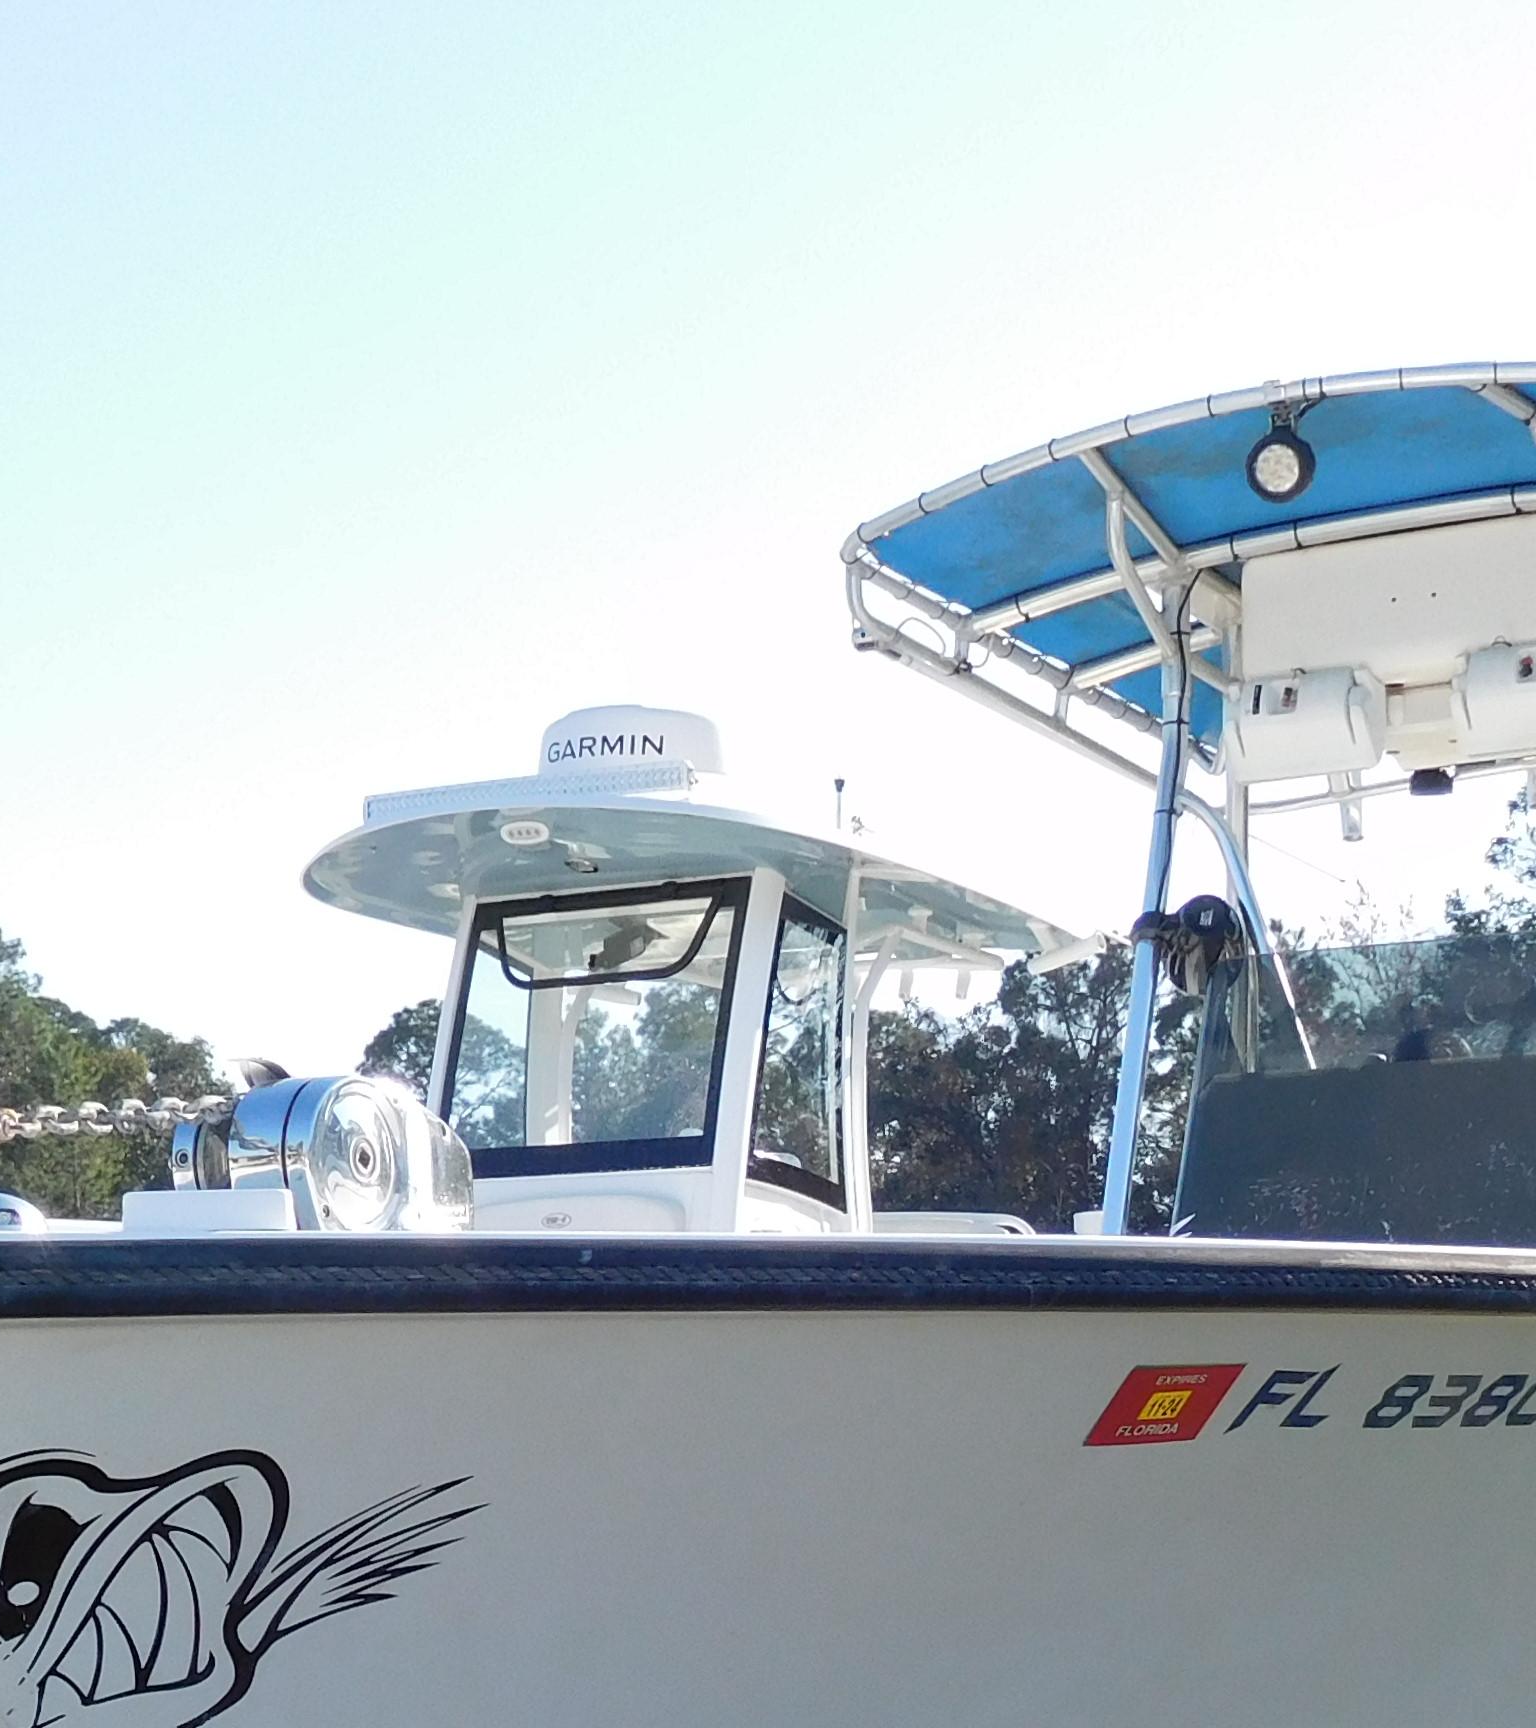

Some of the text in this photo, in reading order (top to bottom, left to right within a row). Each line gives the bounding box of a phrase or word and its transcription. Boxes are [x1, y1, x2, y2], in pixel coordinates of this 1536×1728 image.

[547, 733, 665, 765] GARMIN
[1155, 1373, 1208, 1386] EXPIRES
[1224, 1363, 1342, 1434] FL
[1115, 1423, 1180, 1438] FLORIDA
